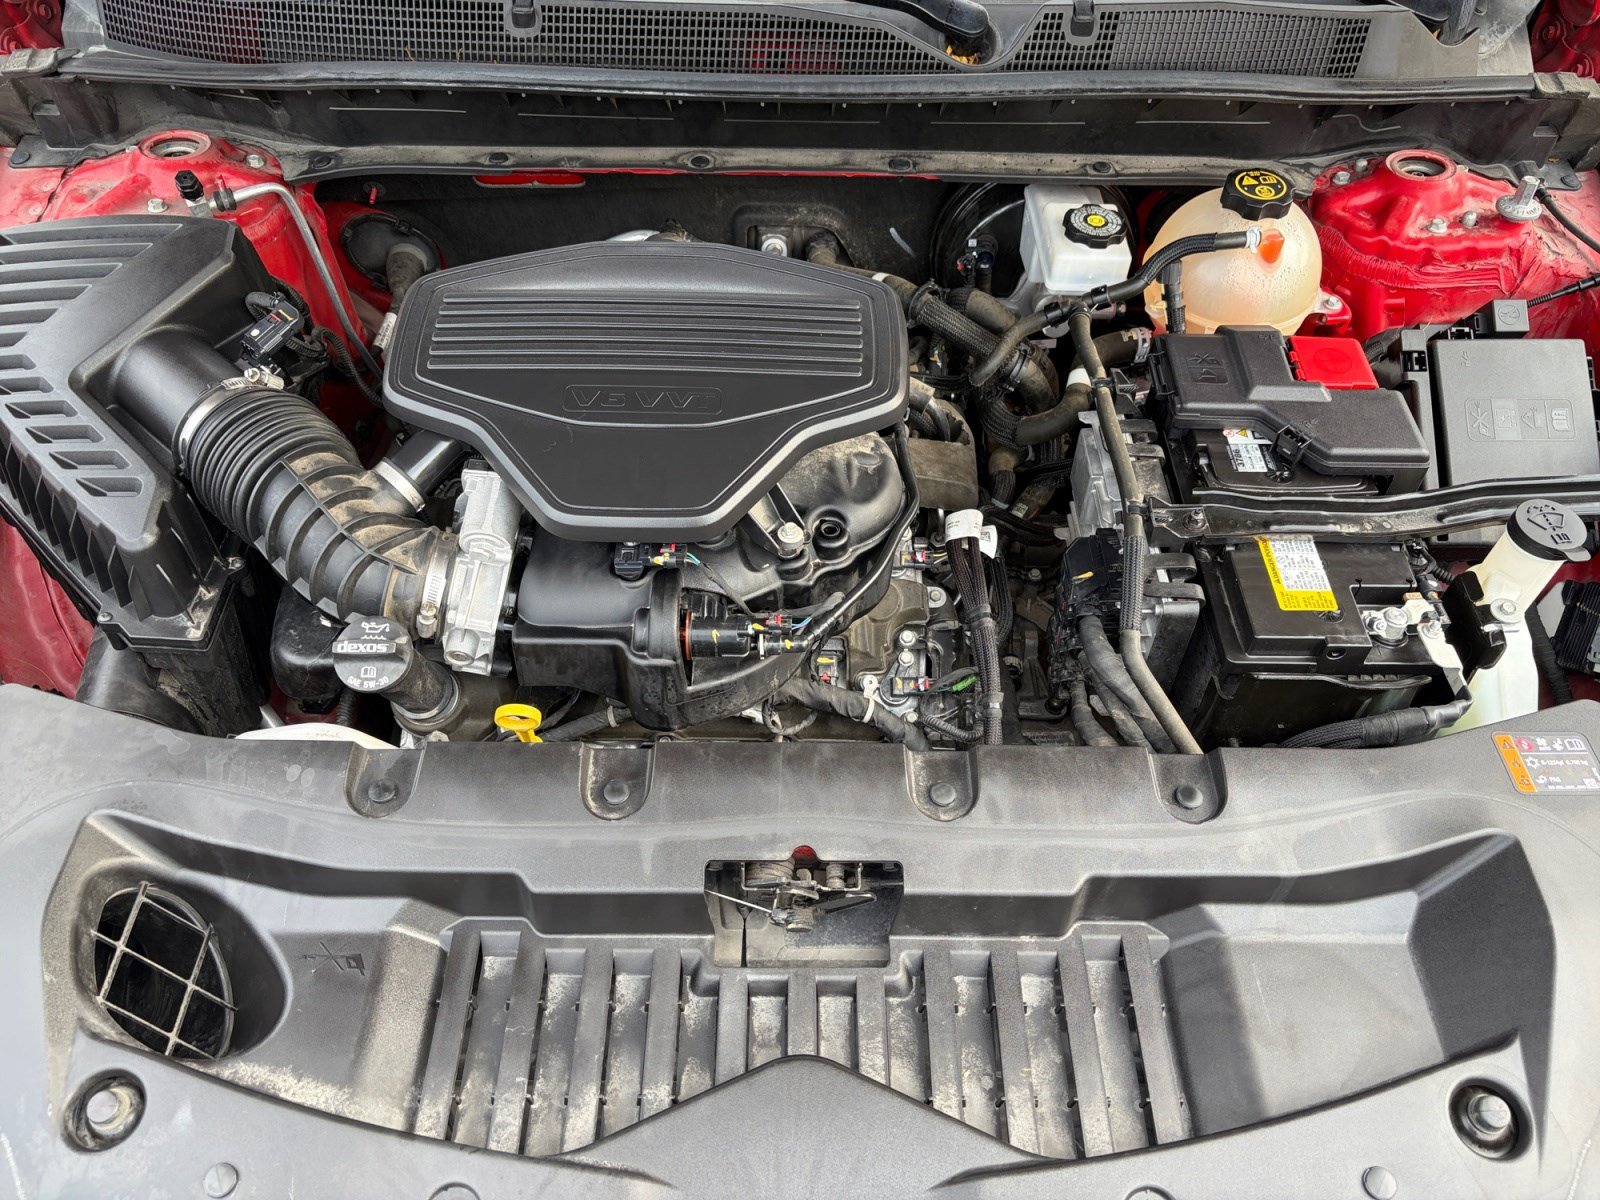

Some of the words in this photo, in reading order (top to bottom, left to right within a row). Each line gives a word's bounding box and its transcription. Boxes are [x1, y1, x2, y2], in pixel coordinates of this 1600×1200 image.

[571, 389, 626, 407] V6
[635, 391, 717, 409] VVT
[337, 641, 390, 653] dexos
[347, 675, 362, 687] SAE
[363, 675, 389, 688] 5W-30
